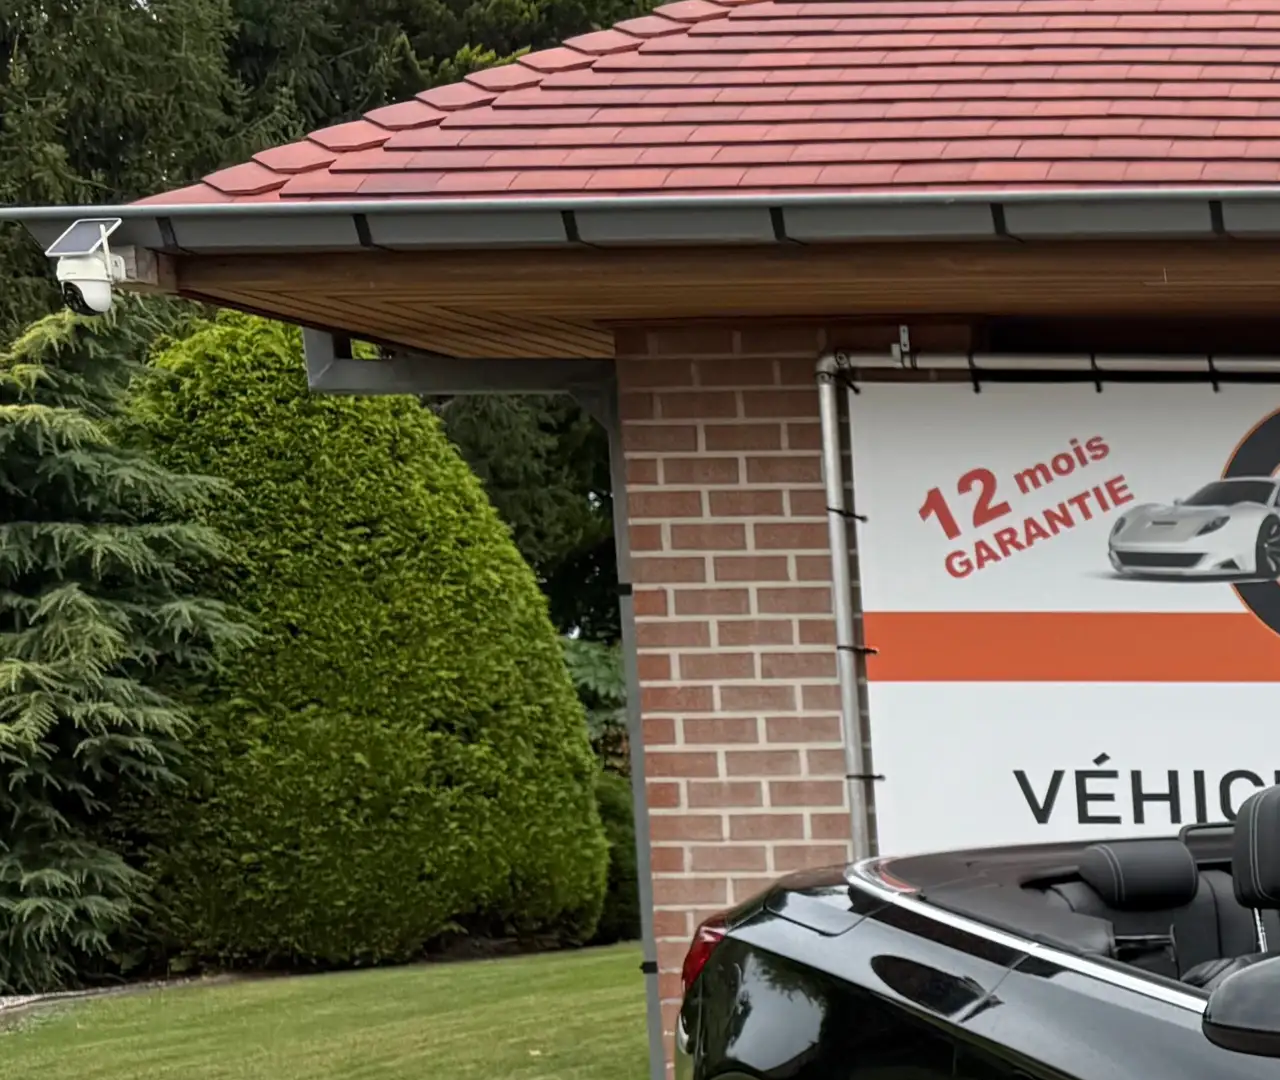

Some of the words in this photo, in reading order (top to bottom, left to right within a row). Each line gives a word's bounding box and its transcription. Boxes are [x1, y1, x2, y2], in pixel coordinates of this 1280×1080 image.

[918, 467, 1013, 541] 12
[1013, 435, 1111, 495] mois
[944, 474, 1136, 579] GARANTIE
